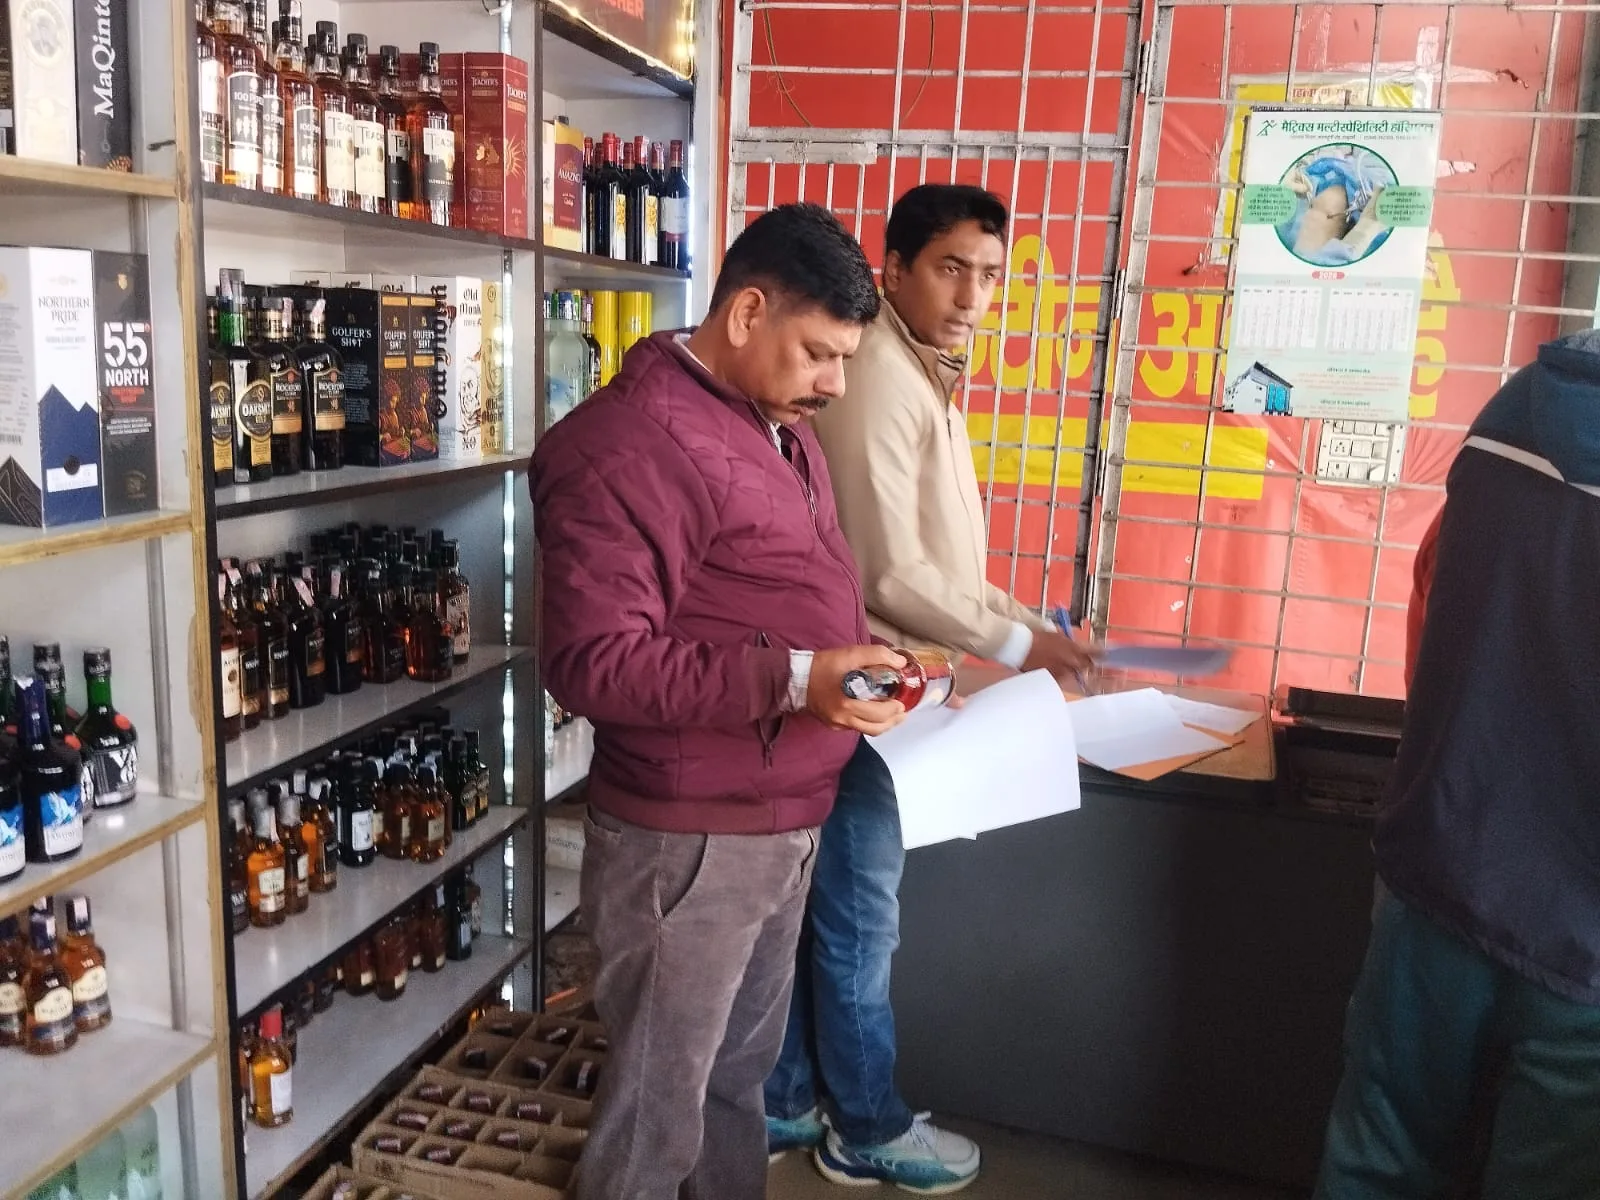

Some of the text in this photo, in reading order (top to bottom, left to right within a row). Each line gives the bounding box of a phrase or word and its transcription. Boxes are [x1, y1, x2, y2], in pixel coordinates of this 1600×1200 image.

[38, 296, 90, 309] NORTHERN
[51, 309, 80, 324] PRIDE
[331, 327, 372, 339] GOLFER'S
[384, 330, 407, 340] GOLFER'S
[412, 329, 435, 339] GOLFER'S
[105, 367, 150, 386] NORTH
